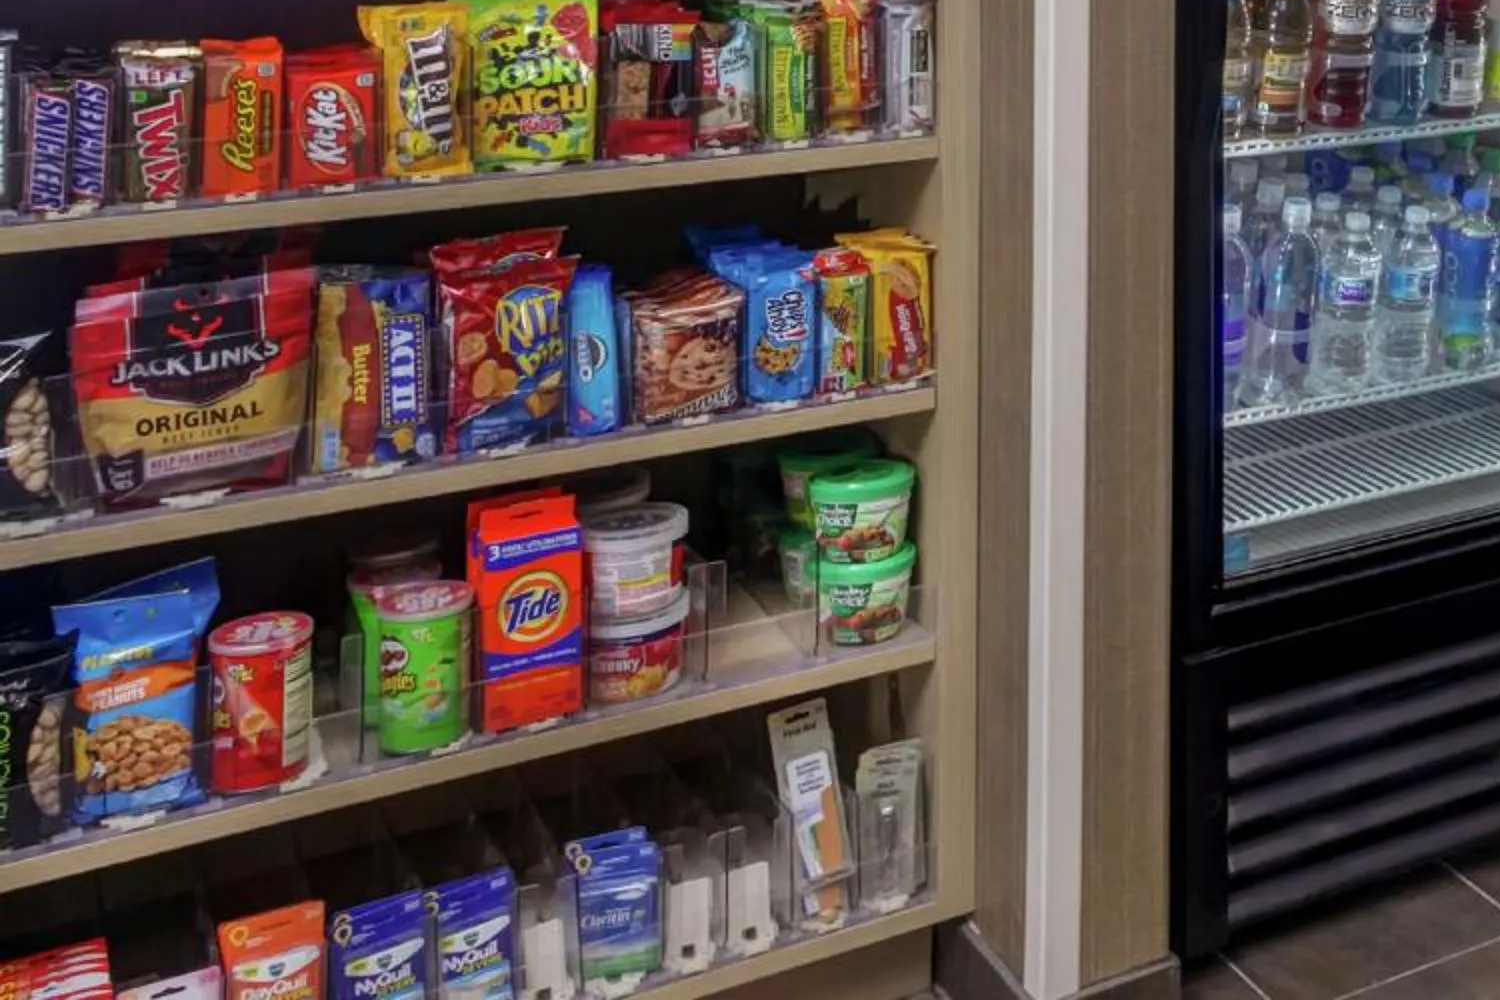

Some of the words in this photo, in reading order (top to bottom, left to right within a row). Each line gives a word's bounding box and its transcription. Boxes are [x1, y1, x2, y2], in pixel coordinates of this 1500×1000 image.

[480, 55, 578, 94] SOUR
[221, 78, 258, 172] Reese's
[476, 84, 585, 129] PATCH
[29, 93, 71, 212] SNICKERS
[71, 79, 110, 200] SNICKERS
[112, 352, 192, 384] JACK
[351, 343, 371, 405] Butter
[135, 400, 264, 437] ORIGINAL
[487, 545, 500, 562] 3
[506, 587, 561, 634] Tide
